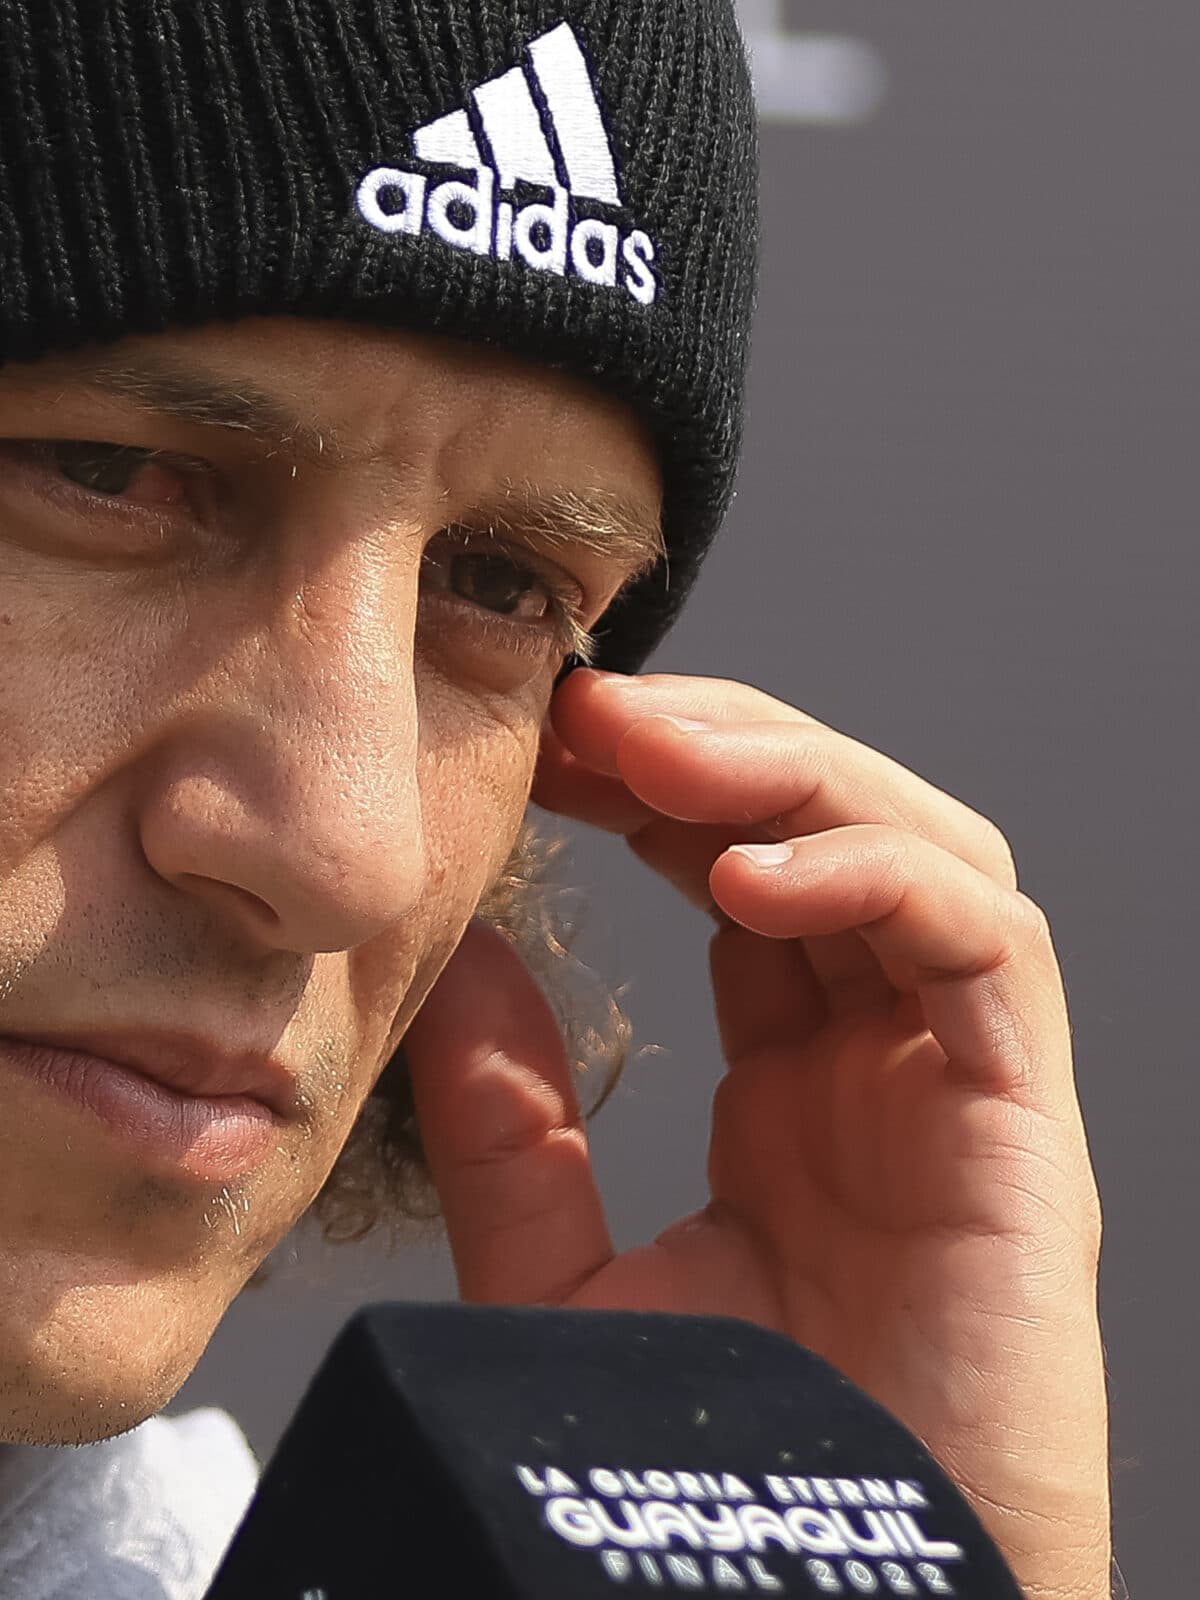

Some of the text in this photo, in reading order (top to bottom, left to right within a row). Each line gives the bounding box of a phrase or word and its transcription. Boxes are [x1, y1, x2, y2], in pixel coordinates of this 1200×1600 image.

[356, 164, 656, 305] adidas
[514, 1464, 930, 1508] LA GLORIA ETERNA
[545, 1497, 964, 1560] GUAYAQUIL
[600, 1549, 955, 1597] FINAL 2022
